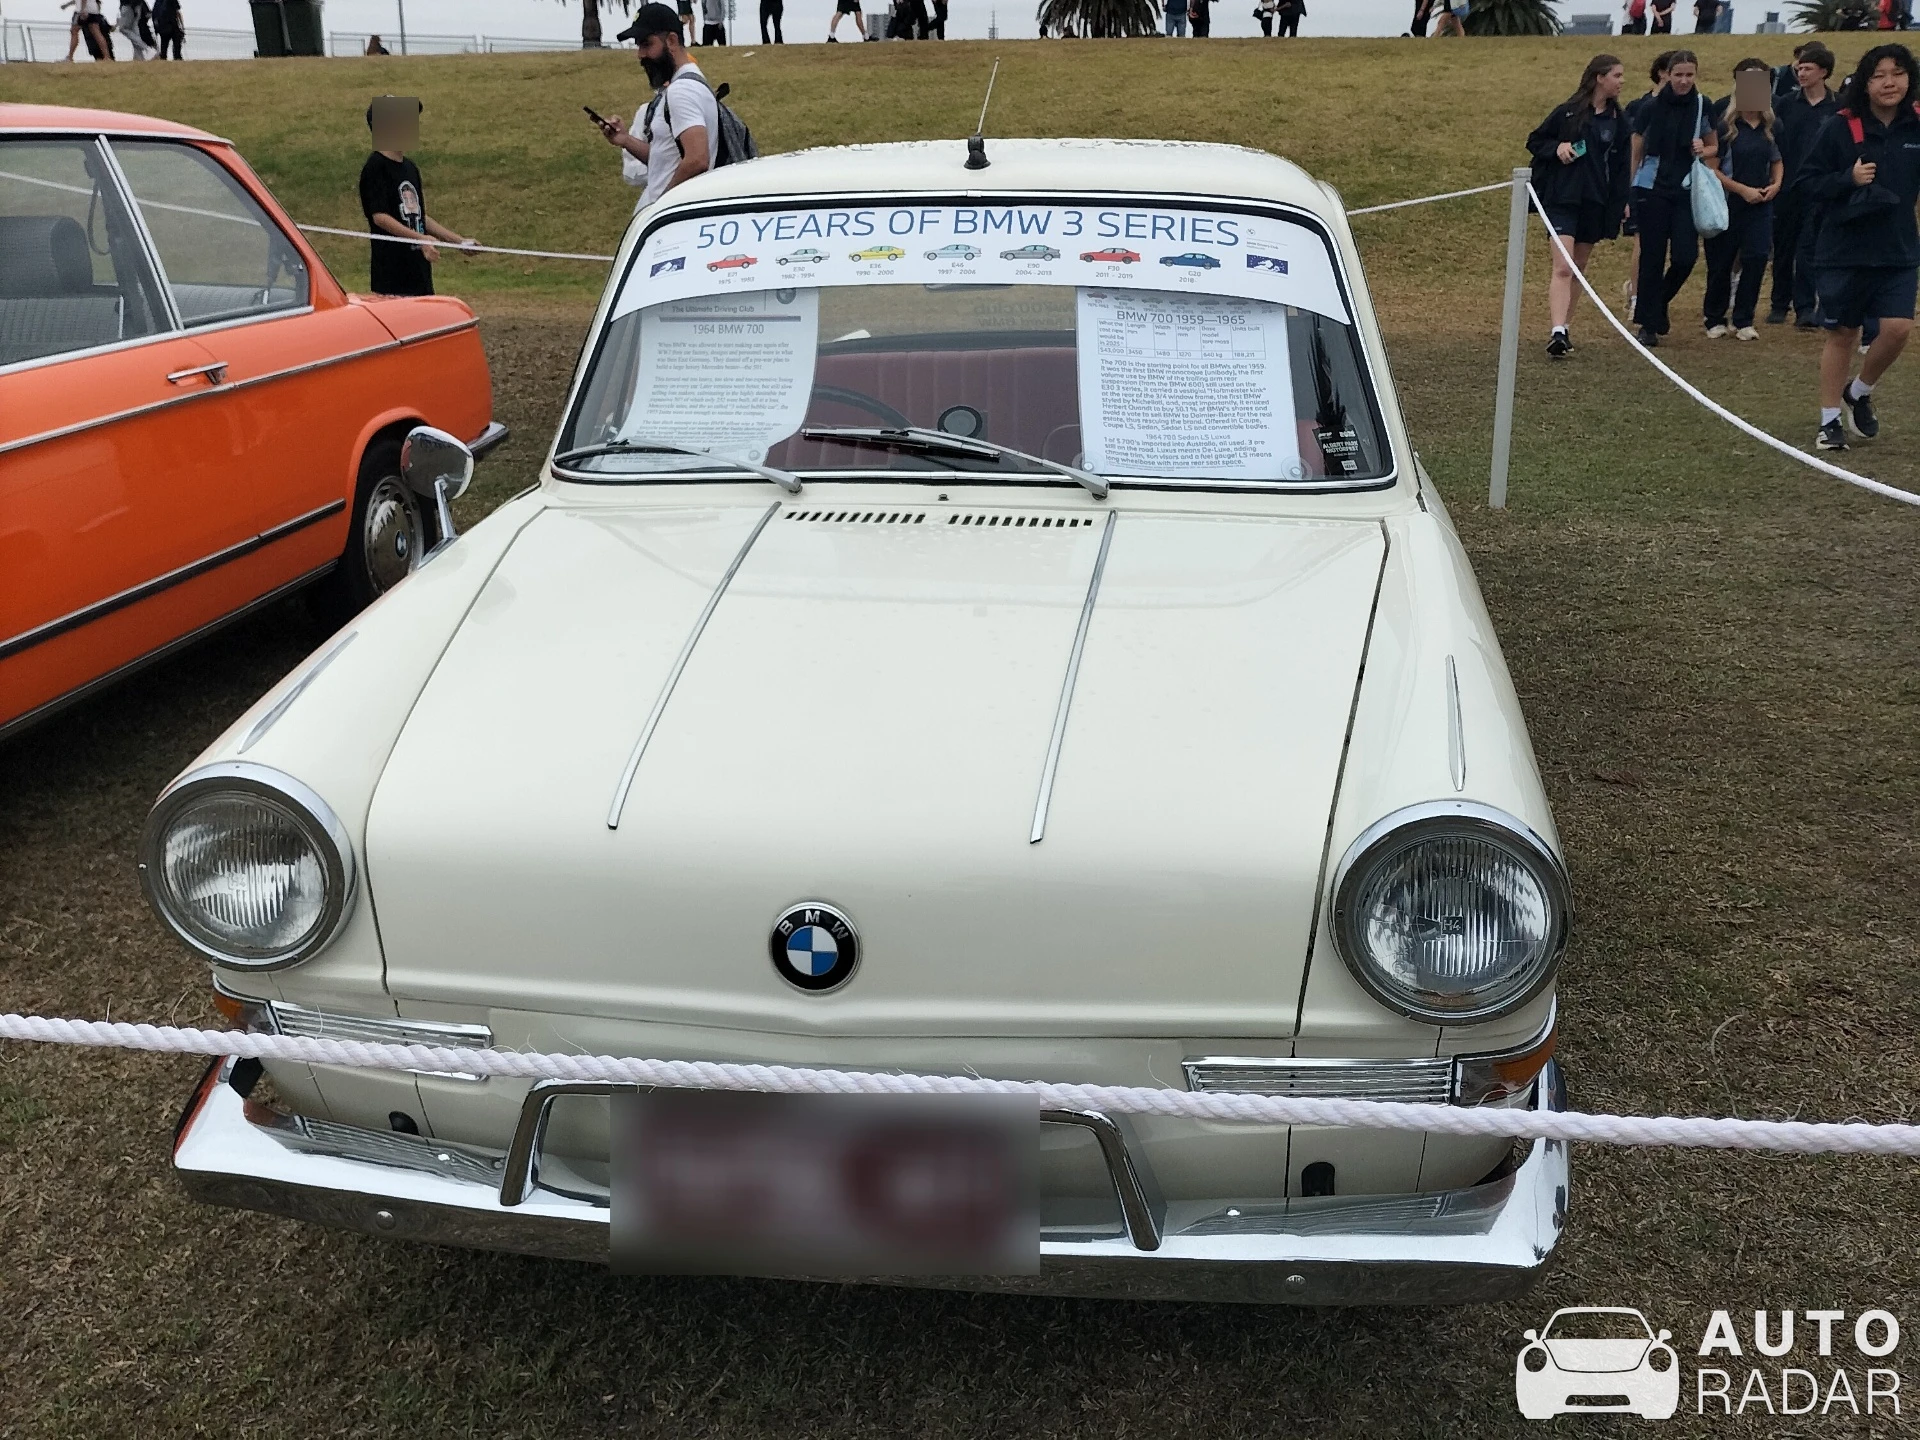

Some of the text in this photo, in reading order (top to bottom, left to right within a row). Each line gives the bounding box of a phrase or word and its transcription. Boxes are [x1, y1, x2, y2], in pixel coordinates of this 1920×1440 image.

[697, 209, 1239, 249] 50 YEARS OF BMW 3 SERIES
[1116, 310, 1148, 321] BMW
[1149, 313, 1173, 324] 700
[693, 324, 764, 334] 1964 BMW 700
[778, 909, 849, 940] BMW
